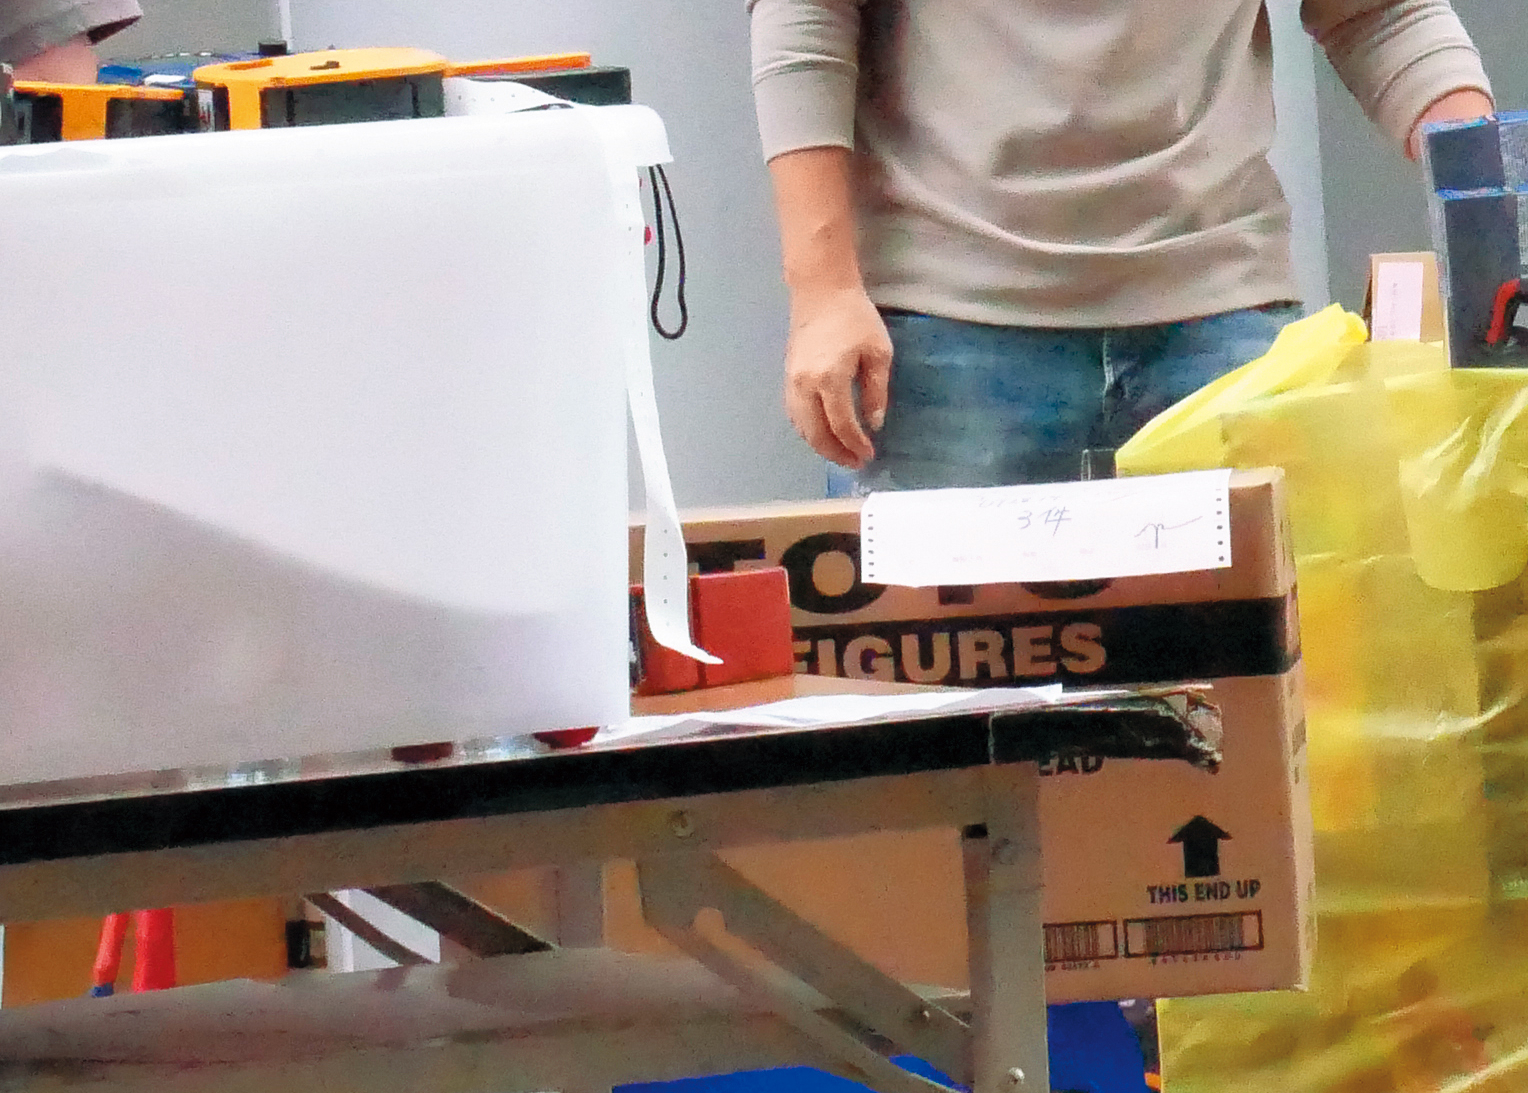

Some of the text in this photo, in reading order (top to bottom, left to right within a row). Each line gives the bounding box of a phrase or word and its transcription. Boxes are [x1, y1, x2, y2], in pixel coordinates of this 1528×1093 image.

[1147, 879, 1261, 904] THIS END UP
